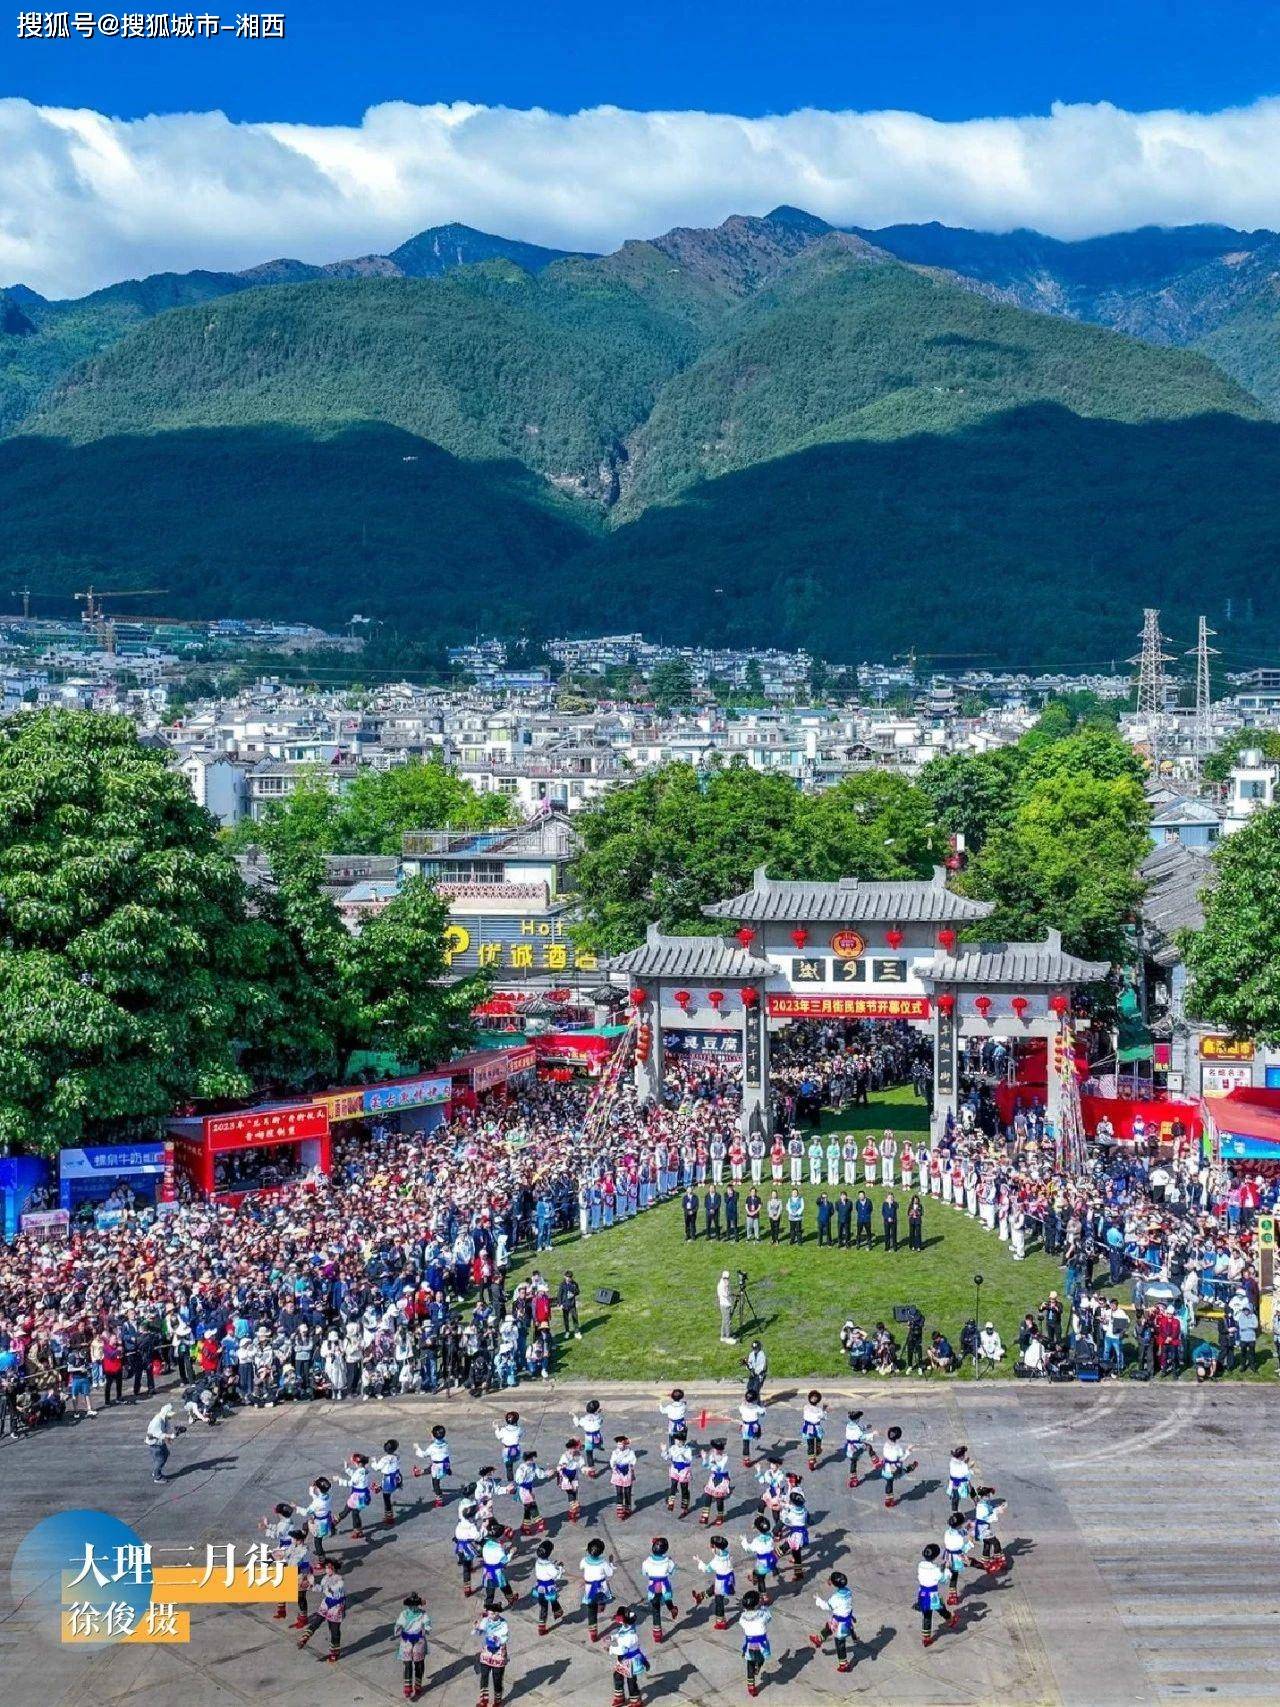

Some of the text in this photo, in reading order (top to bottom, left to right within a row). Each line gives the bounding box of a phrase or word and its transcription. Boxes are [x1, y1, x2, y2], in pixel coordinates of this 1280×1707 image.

[773, 999, 922, 1015] 2023年三月街民族节开幕仪式
